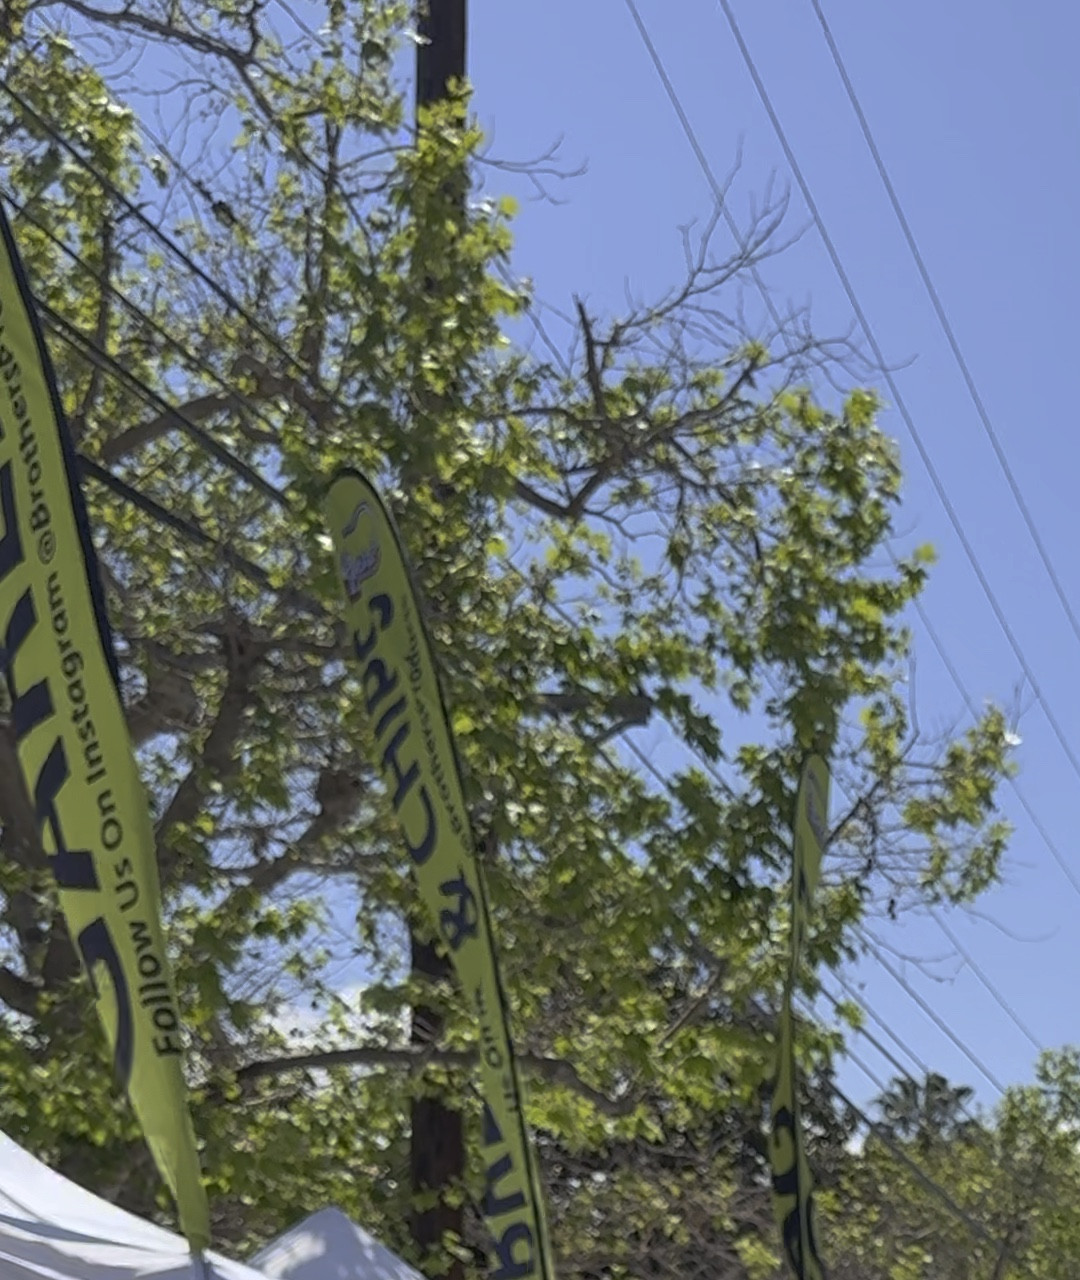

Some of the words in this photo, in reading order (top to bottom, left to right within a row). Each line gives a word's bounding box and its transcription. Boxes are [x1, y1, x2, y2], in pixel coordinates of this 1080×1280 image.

[46, 569, 108, 786] Instagram
[354, 593, 437, 866] CHIPS
[96, 787, 124, 852] On
[113, 858, 141, 914] Us
[129, 919, 182, 1058] Follow
